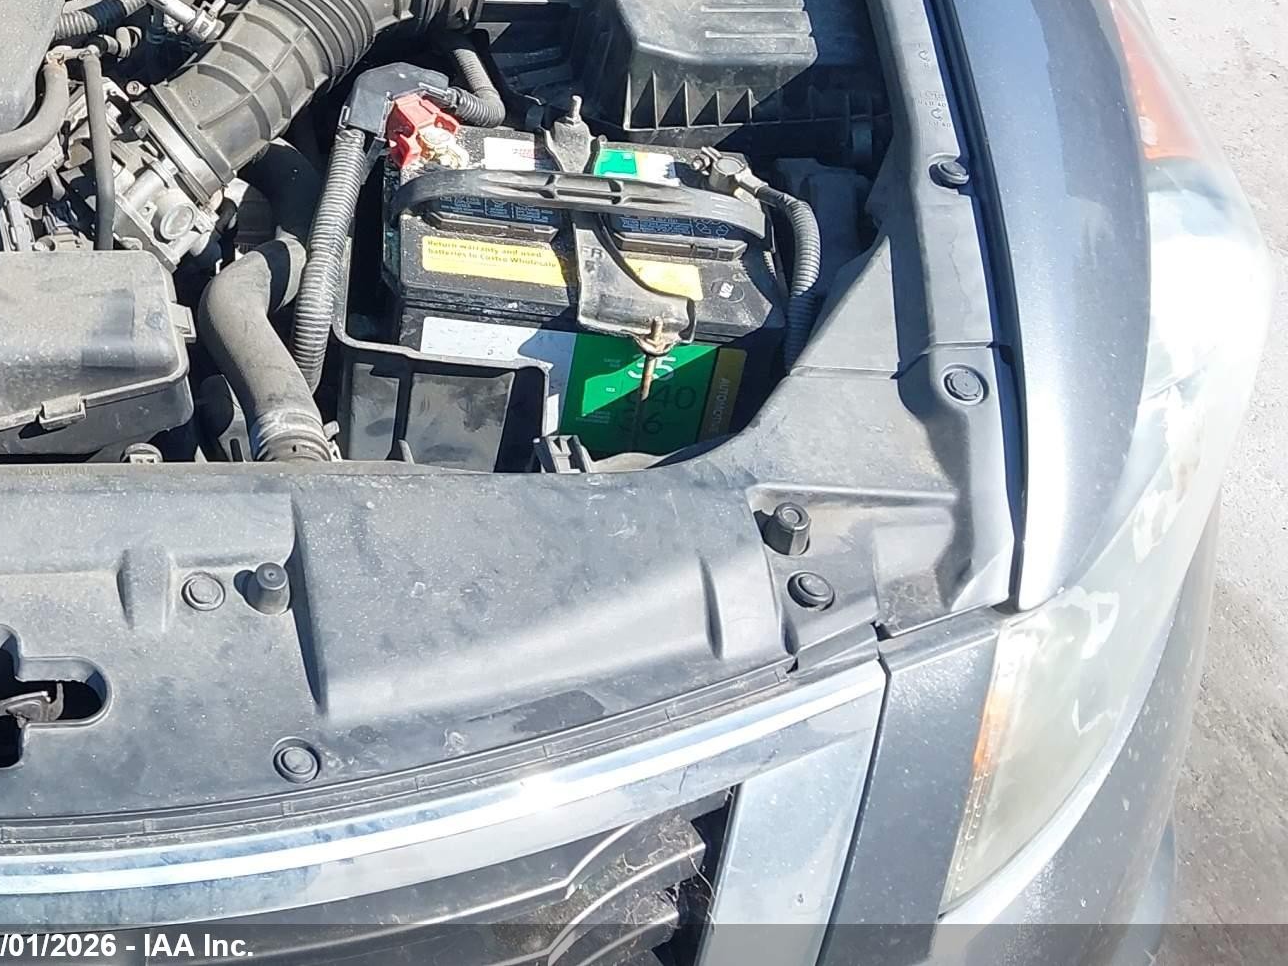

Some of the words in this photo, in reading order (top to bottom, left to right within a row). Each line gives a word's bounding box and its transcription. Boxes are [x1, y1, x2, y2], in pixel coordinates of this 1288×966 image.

[427, 240, 458, 249] Return
[459, 243, 499, 255] warranty
[502, 248, 519, 257] and
[520, 250, 542, 259] used
[427, 247, 467, 258] batteries
[509, 255, 557, 268] Wholesale
